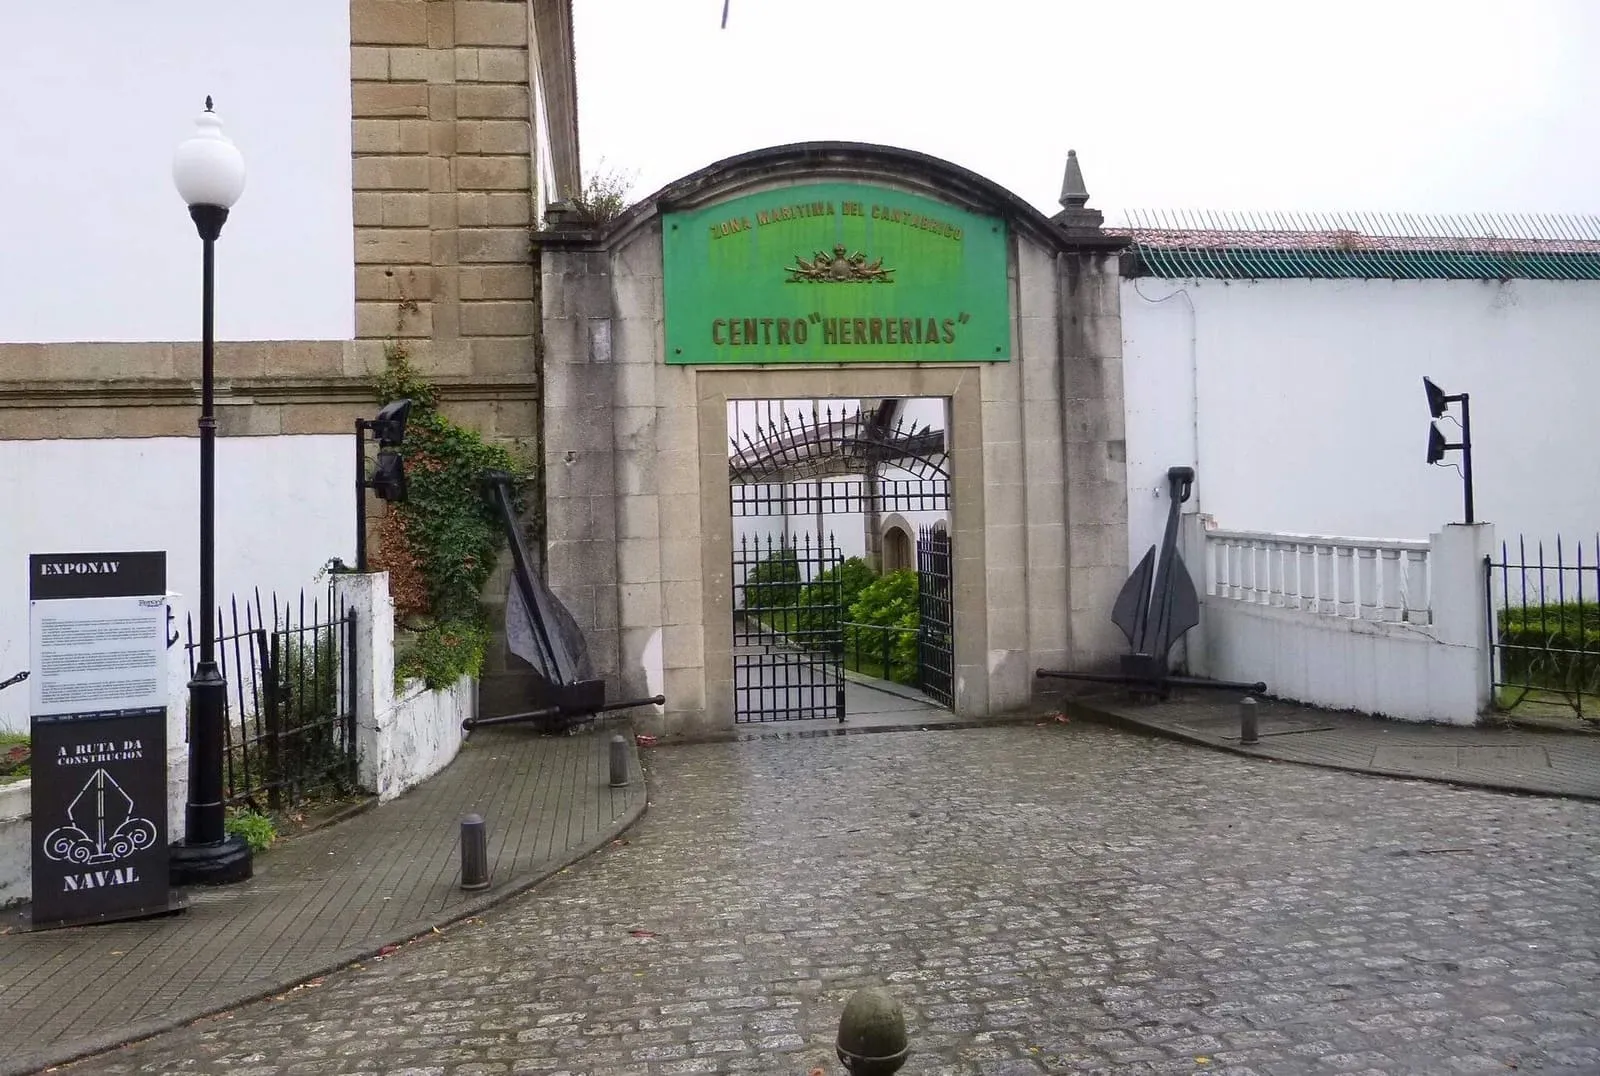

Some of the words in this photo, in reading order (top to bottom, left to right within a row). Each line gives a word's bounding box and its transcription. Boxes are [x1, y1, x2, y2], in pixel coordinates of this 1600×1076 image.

[709, 216, 752, 240] ZONA
[755, 201, 836, 226] MARITIMA
[841, 200, 865, 216] DEL
[871, 203, 963, 241] CANTABRICO
[712, 317, 808, 345] CENTRO
[41, 561, 120, 576] EXPONAV
[57, 750, 143, 766] CONSTRUCION
[58, 746, 67, 756] A
[76, 742, 115, 755] RUTA
[123, 739, 142, 750] DA
[63, 866, 140, 892] NAVAL
